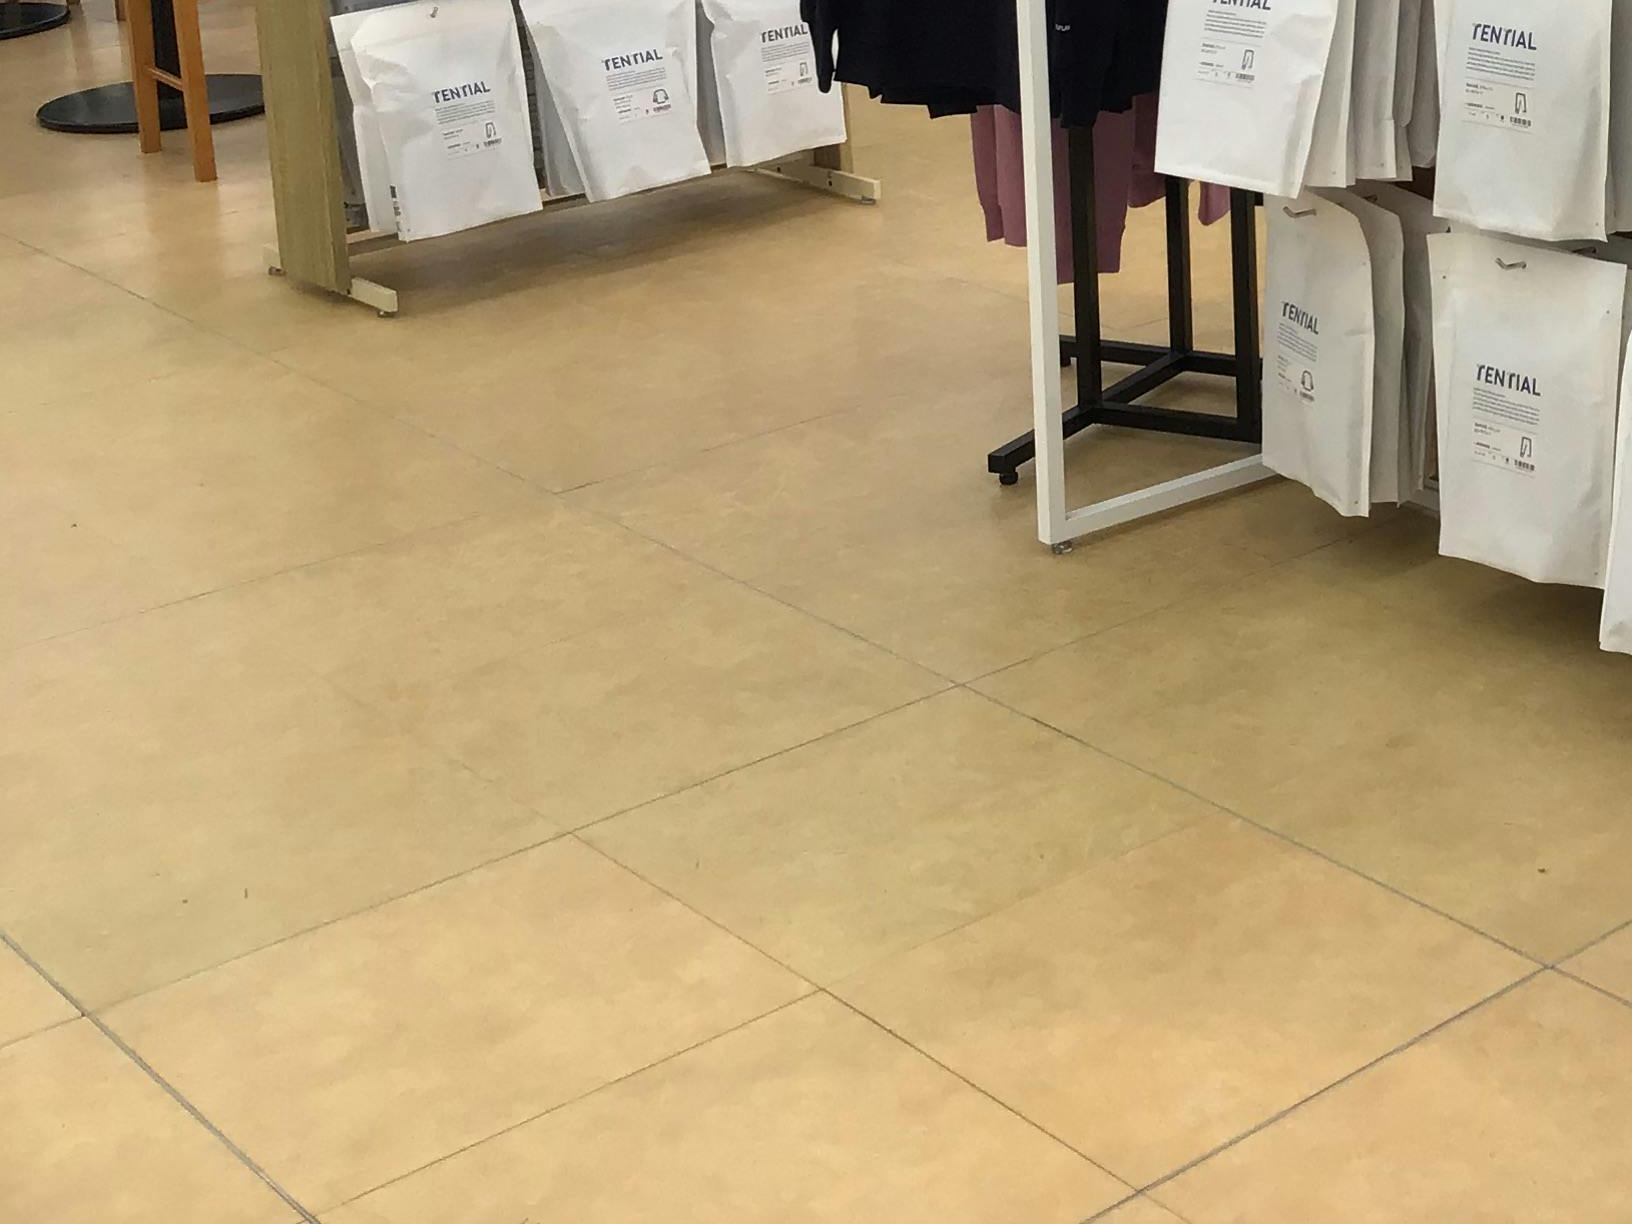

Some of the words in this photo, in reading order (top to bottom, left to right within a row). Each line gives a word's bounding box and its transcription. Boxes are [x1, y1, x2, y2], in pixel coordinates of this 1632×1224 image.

[761, 24, 808, 43] TENTIAL
[1471, 22, 1538, 51] TENTIAL
[602, 48, 665, 71] TENTIAL
[432, 81, 492, 104] TENTIAL
[1280, 300, 1320, 336] TENTIAL
[1474, 363, 1542, 397] TENTIAL
